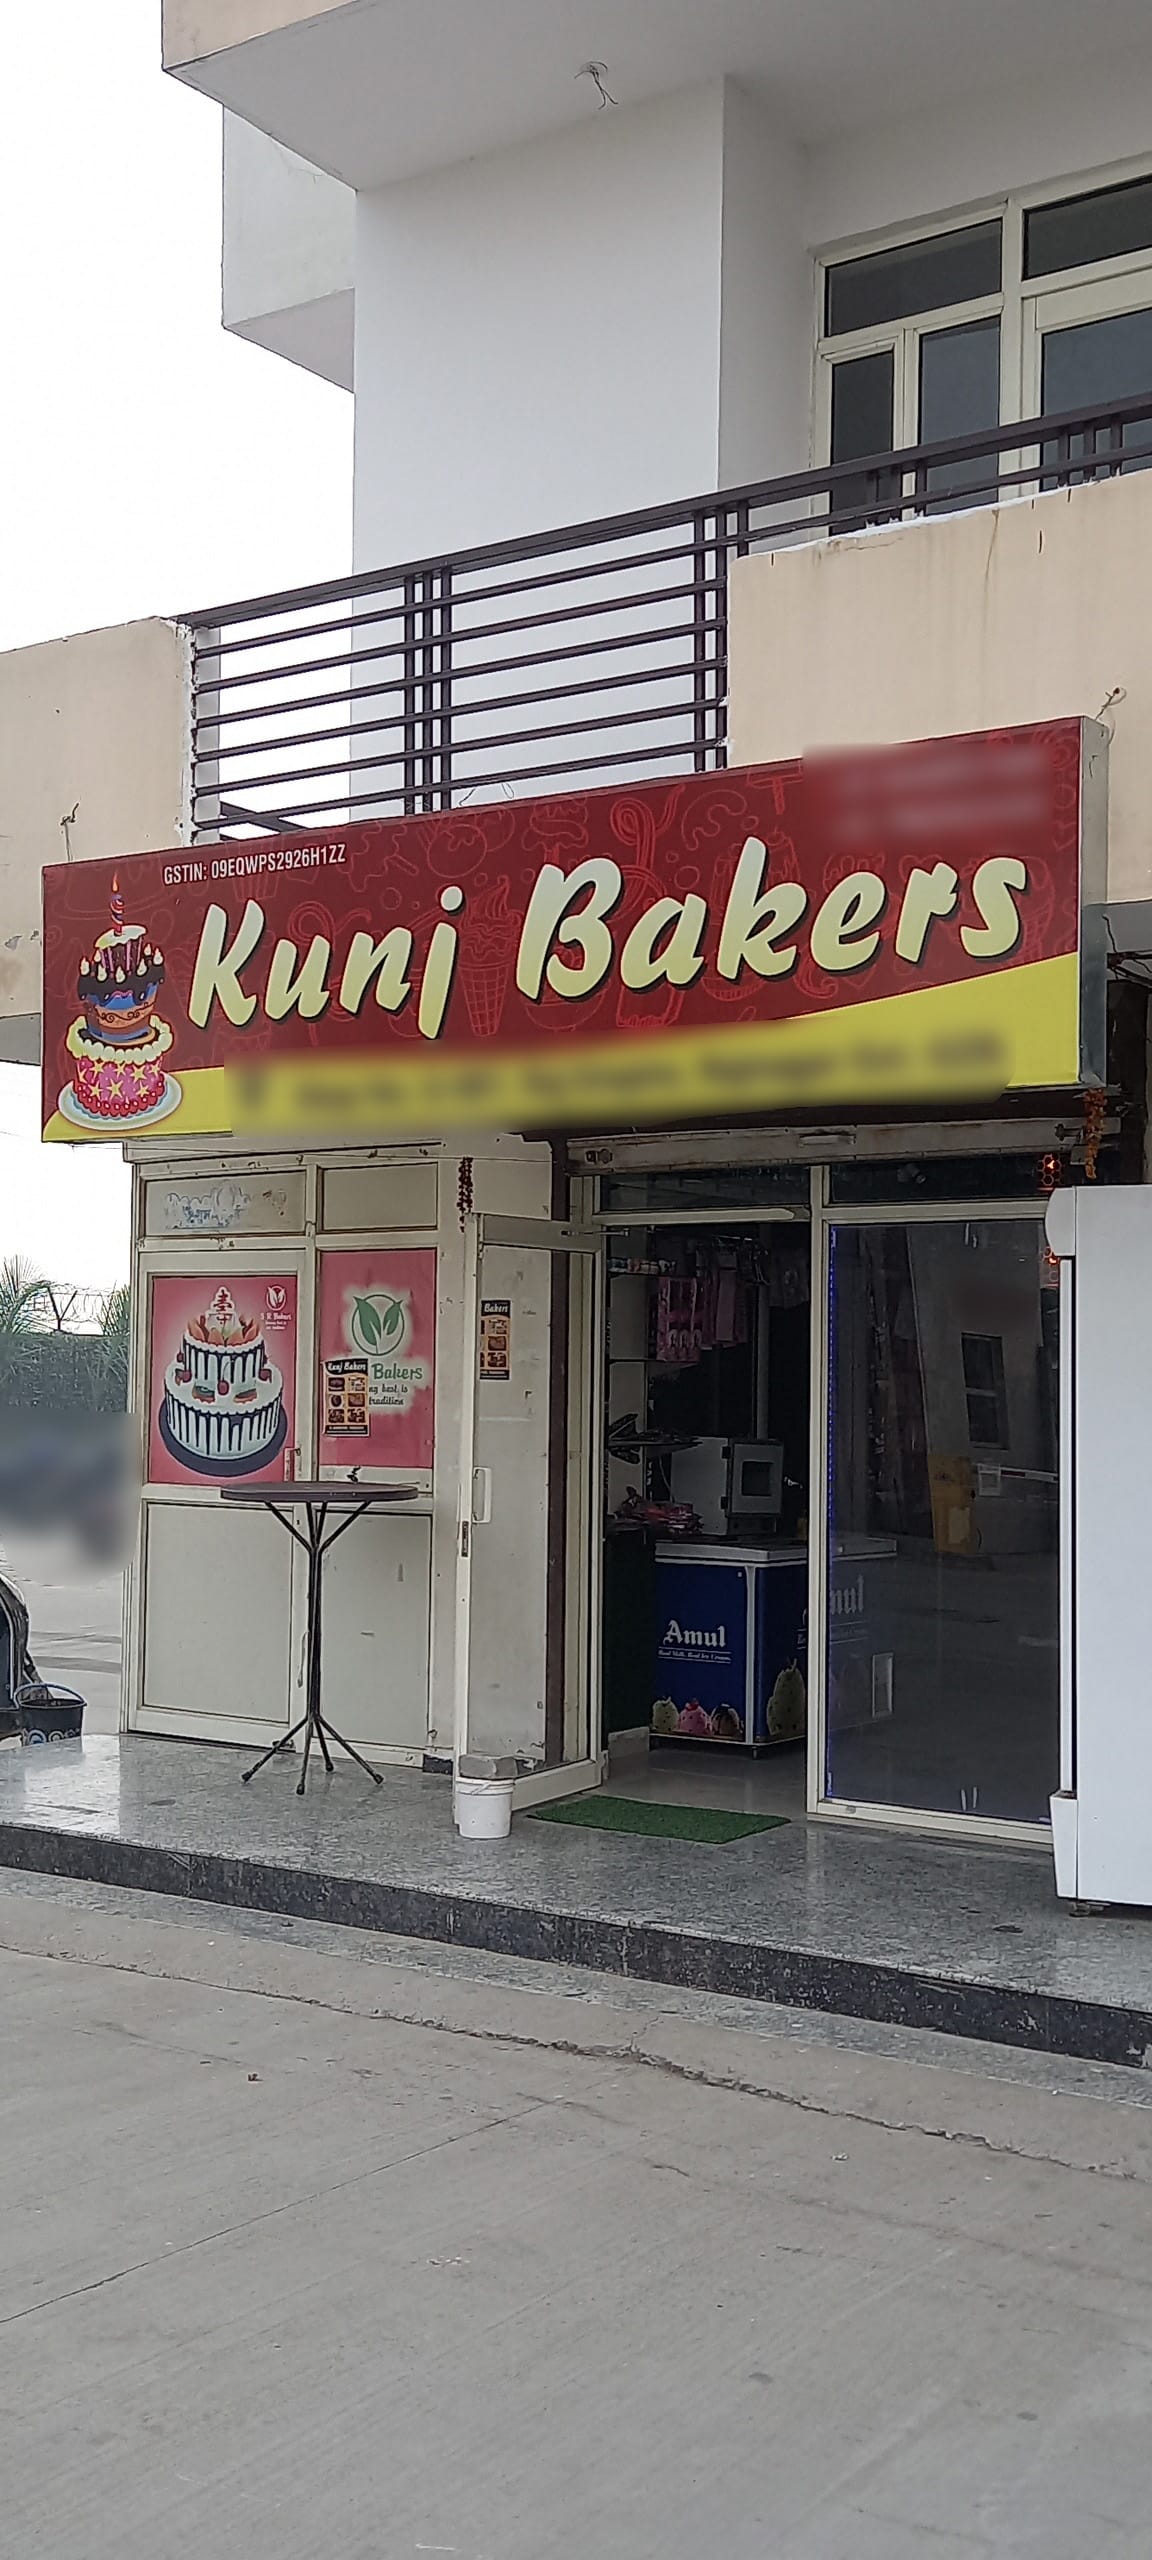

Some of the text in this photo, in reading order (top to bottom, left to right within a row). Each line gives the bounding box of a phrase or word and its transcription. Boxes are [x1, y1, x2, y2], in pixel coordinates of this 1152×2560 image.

[164, 844, 346, 885] GSTIN: 09EQWPS2926H1ZZ
[188, 836, 1027, 1040] Kunj Bakers
[371, 1363, 423, 1380] Bakers
[663, 1620, 726, 1647] Amul
